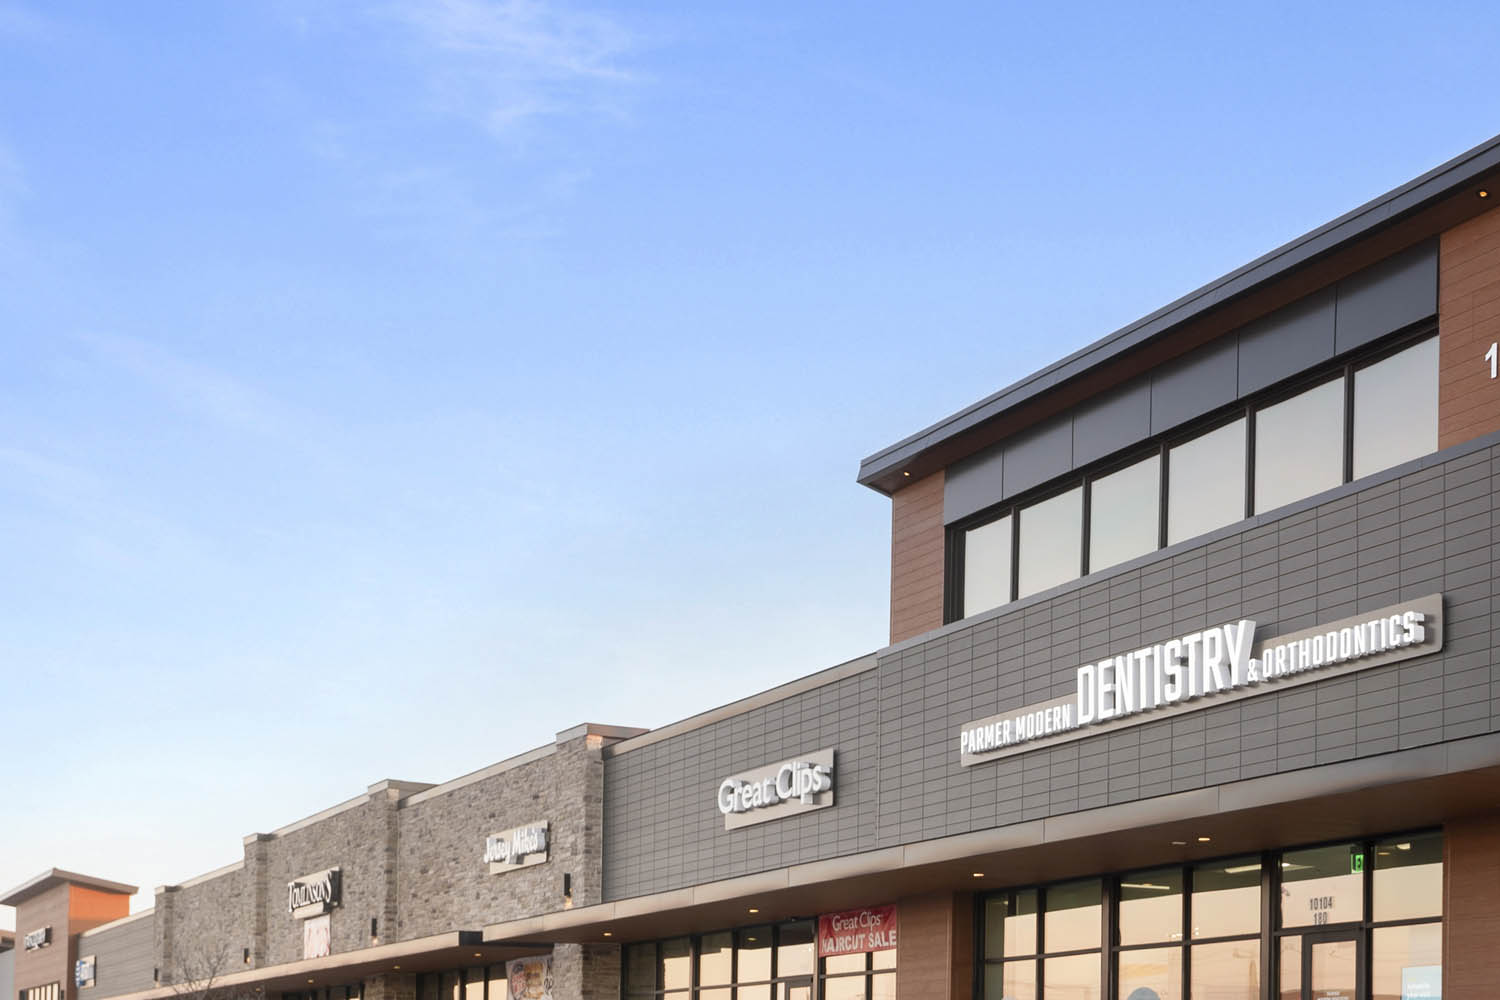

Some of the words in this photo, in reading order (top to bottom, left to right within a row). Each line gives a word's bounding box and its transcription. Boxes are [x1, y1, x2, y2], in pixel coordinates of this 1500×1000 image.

[961, 719, 1011, 755] PARMER
[1015, 704, 1071, 741] MODERN
[1077, 620, 1254, 725] DENTISTRY
[1248, 658, 1261, 682] &
[1263, 611, 1422, 678] ORTHODONTICS
[718, 778, 774, 814] Great
[776, 761, 825, 805] Clips
[1310, 896, 1333, 911] 10104
[832, 915, 858, 931] Great
[860, 911, 881, 931] Clips
[822, 934, 865, 953] HAIRCUT
[868, 930, 897, 948] SALE
